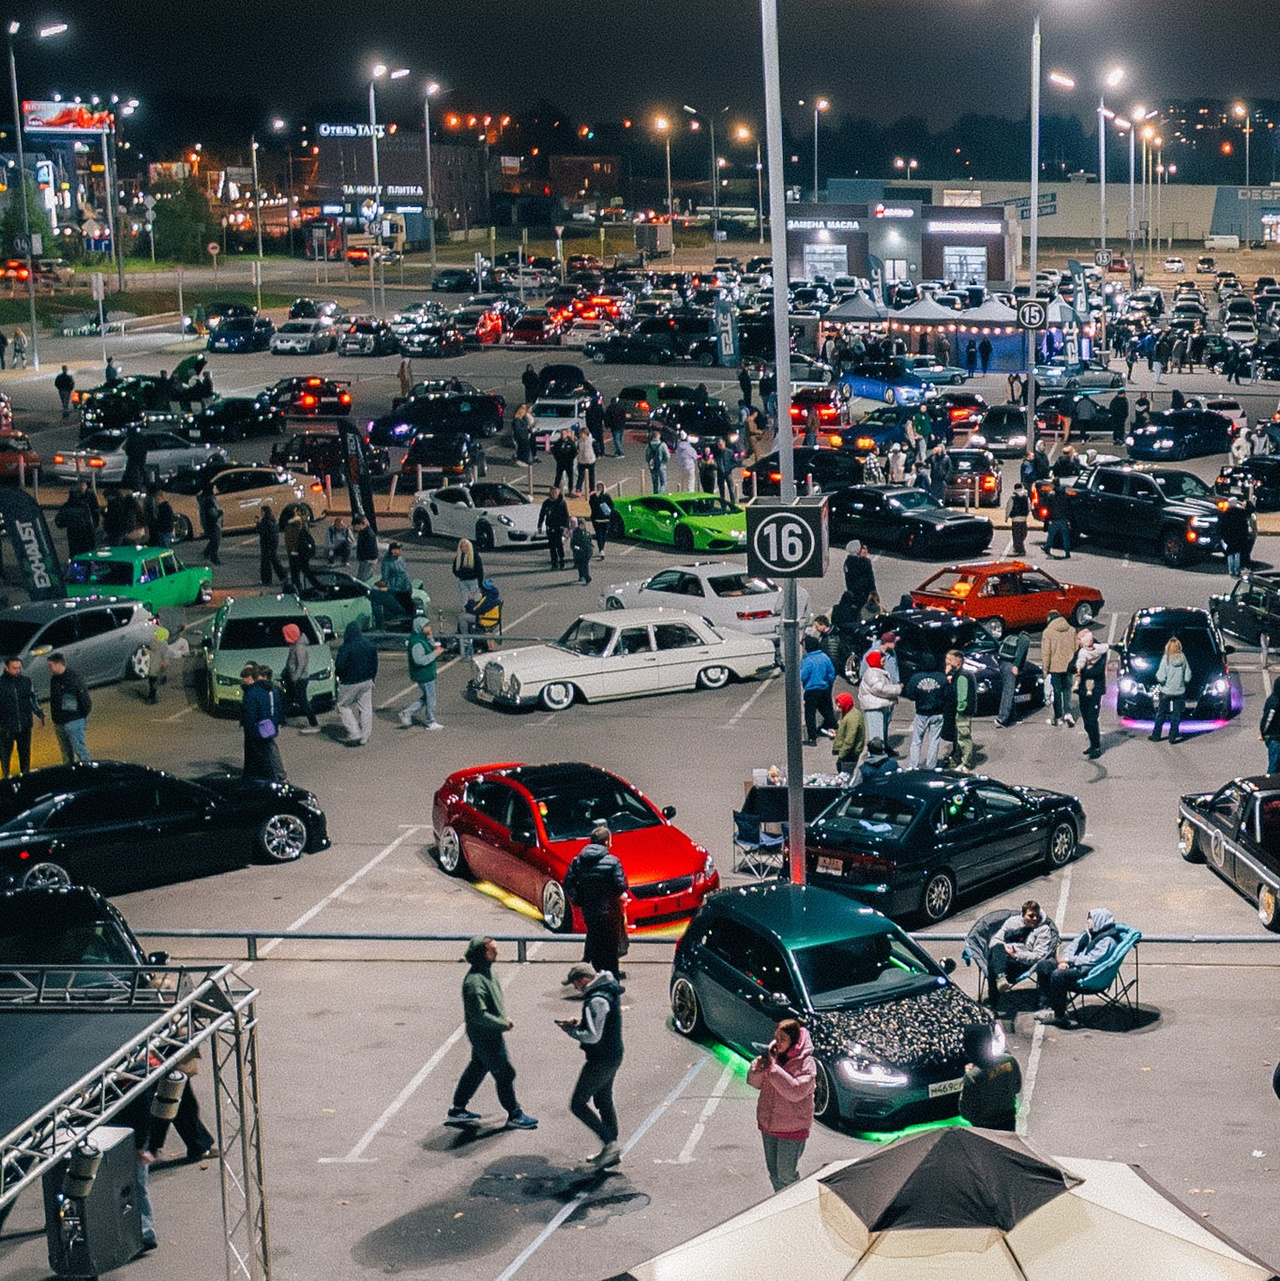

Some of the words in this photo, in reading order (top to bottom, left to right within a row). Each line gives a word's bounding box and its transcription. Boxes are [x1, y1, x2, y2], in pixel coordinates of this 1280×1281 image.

[787, 220, 825, 230] ЗАМЕНА
[827, 220, 860, 230] МАСЛА
[1024, 307, 1041, 322] 15
[15, 519, 53, 589] EXHAUST
[764, 523, 803, 561] 16
